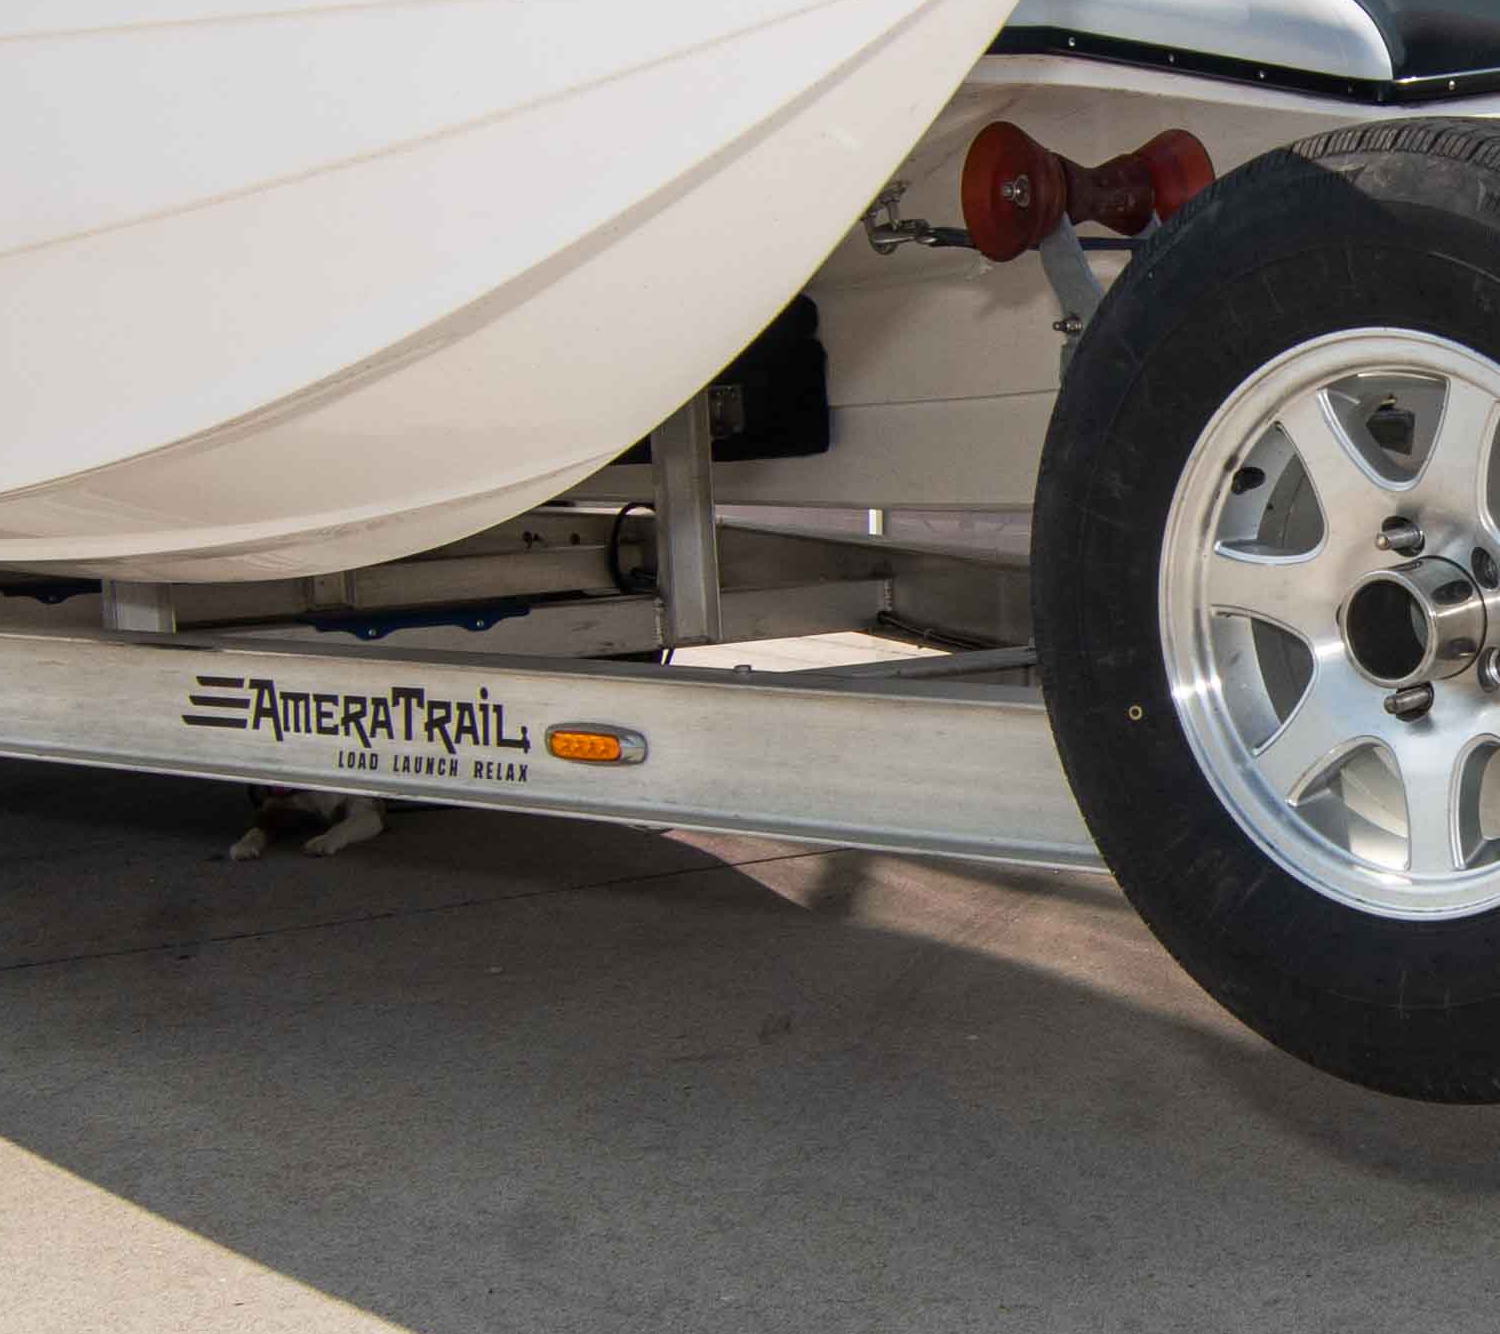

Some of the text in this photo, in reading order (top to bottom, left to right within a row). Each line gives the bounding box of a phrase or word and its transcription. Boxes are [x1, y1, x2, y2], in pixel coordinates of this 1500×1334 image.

[338, 750, 529, 783] LOAD LAUNCH RELAX
